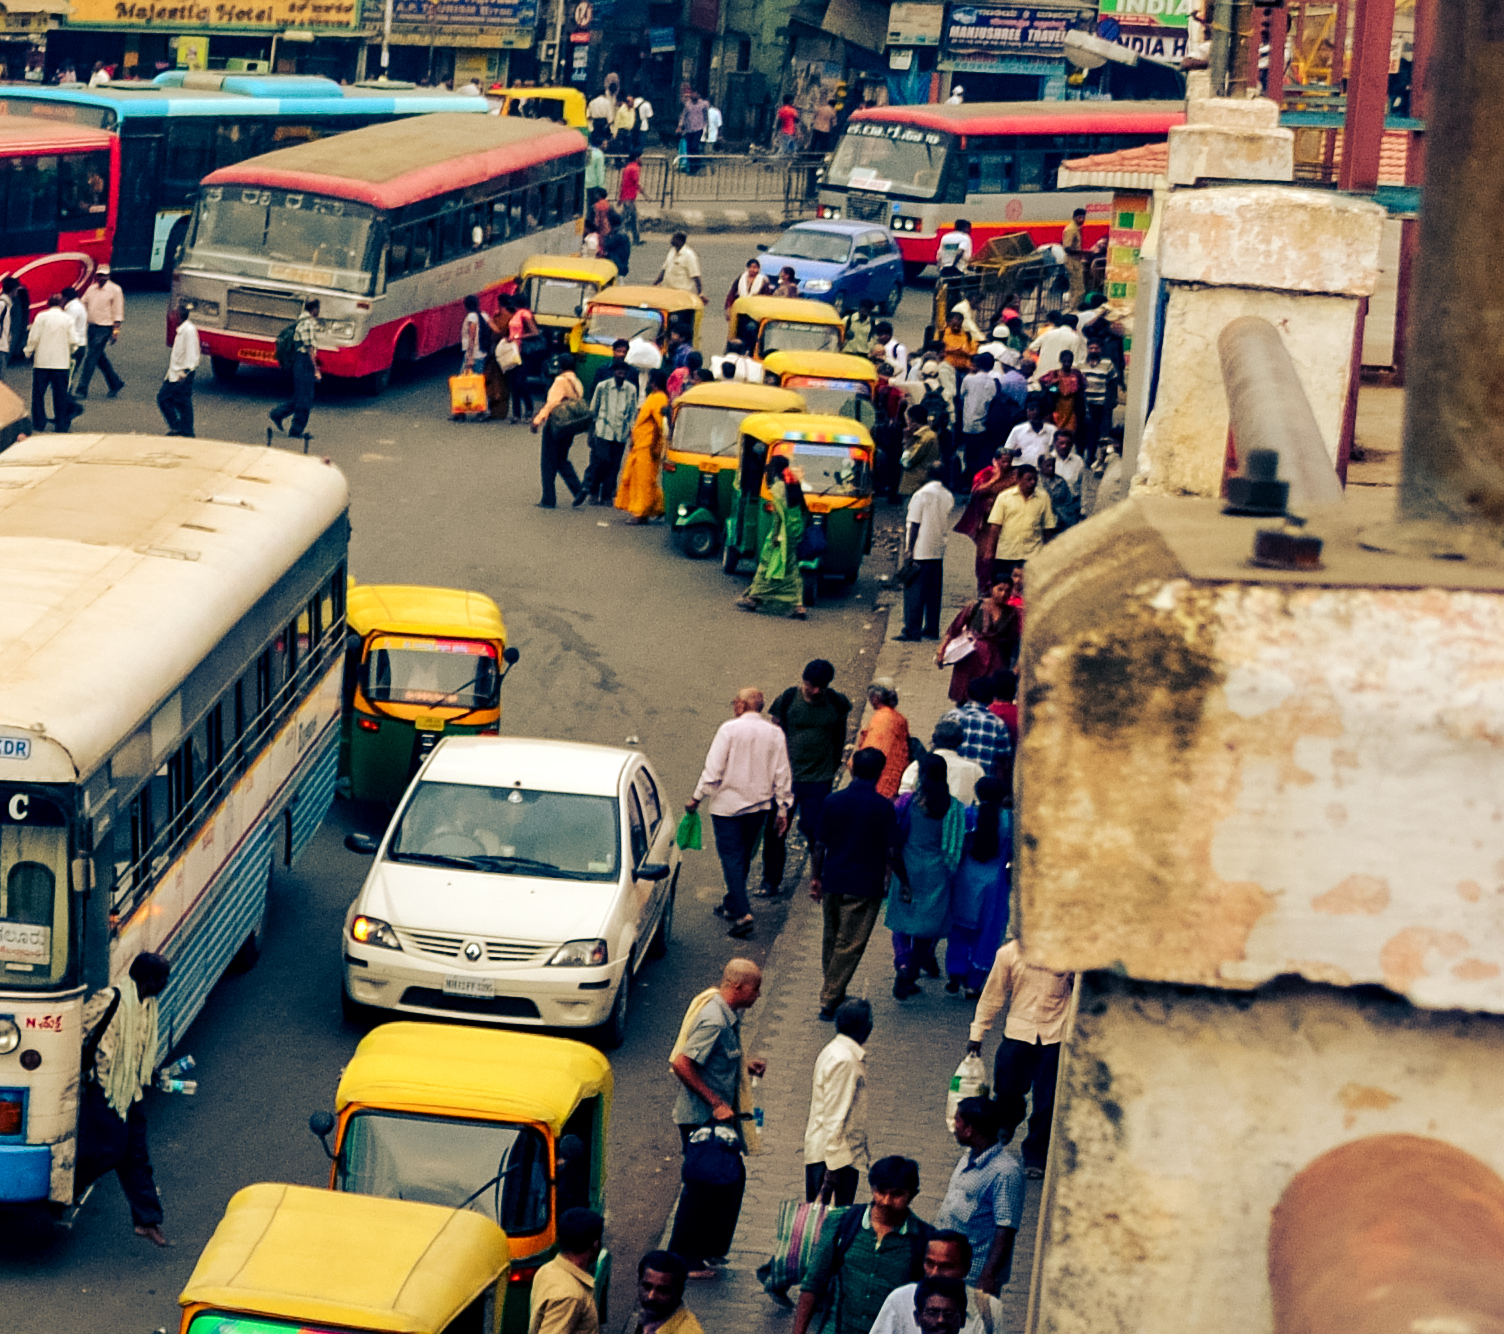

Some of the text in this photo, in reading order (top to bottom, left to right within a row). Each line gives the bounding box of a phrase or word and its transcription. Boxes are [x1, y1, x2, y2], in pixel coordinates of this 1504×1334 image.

[115, 2, 210, 21] Majestic
[215, 3, 274, 22] Hotel
[1118, 35, 1164, 57] NDIA
